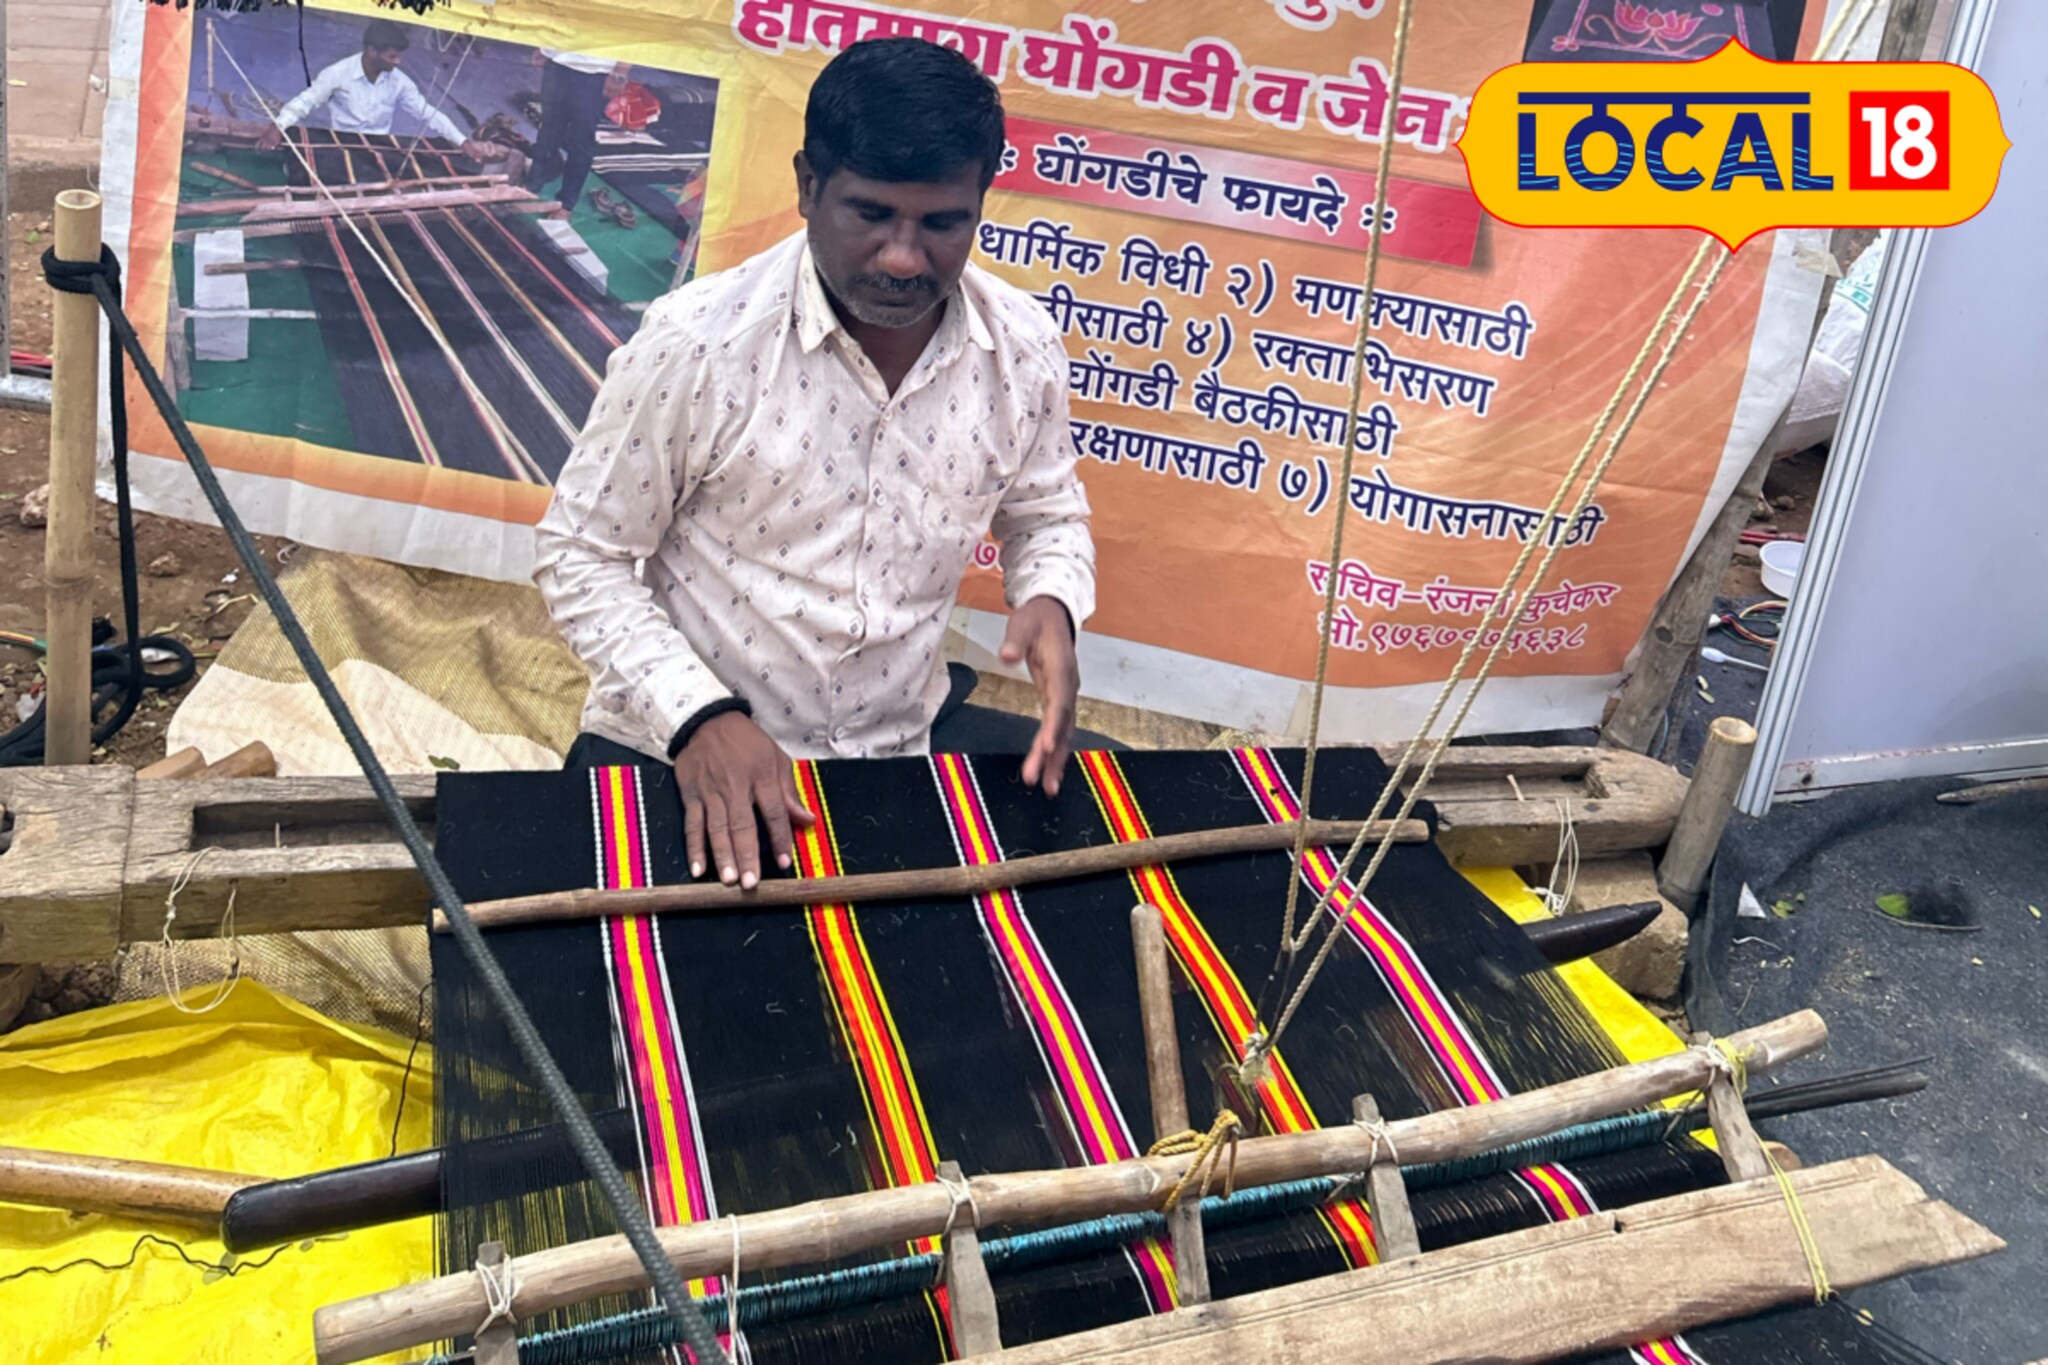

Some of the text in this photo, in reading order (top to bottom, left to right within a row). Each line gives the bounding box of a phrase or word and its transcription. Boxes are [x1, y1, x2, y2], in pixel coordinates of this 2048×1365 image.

[1024, 20, 1240, 113] घोंगडी
[1252, 73, 1309, 122] व
[1323, 64, 1452, 145] जेन
[1036, 136, 1345, 233] घोंगडीचे फायदे
[979, 220, 1532, 356] धार्मिक विधी २) मणक्यासाठी
[1185, 316, 1232, 367] ४)
[1254, 333, 1494, 413] रक्ताभिसरण
[1195, 371, 1397, 455] बैठकीसाठी
[1281, 459, 1329, 513] ७)
